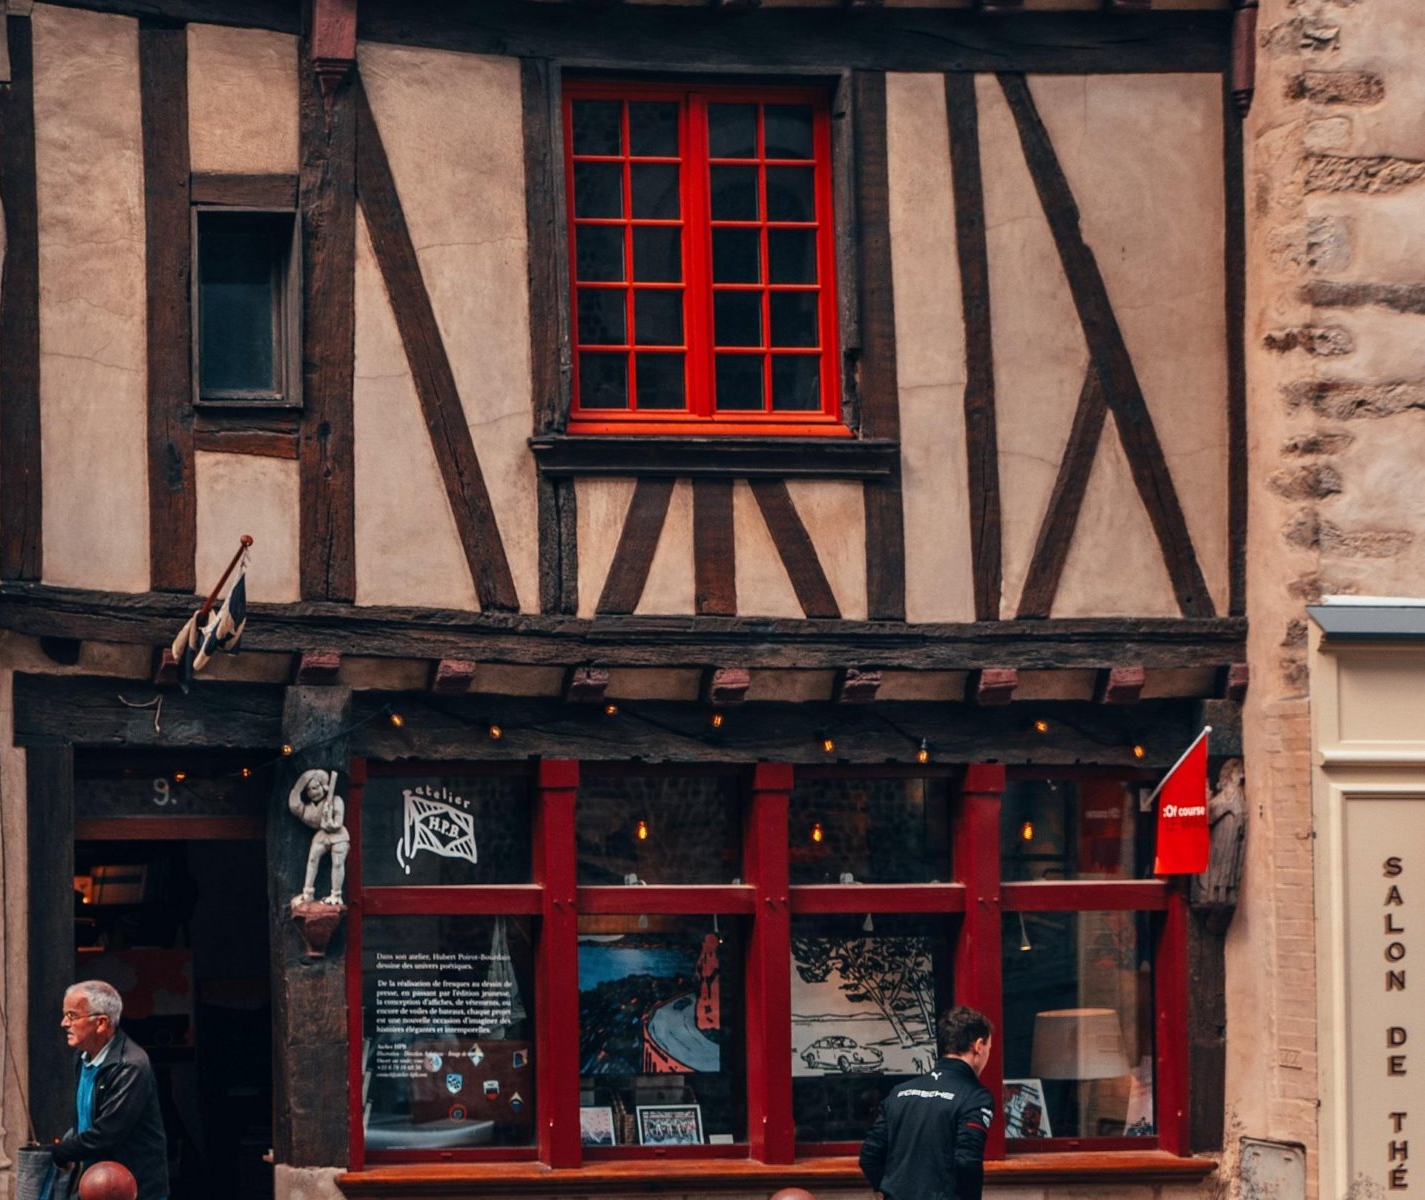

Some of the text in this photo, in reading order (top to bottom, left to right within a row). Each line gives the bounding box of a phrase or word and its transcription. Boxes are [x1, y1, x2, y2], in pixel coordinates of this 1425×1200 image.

[415, 785, 470, 808] atelier
[1178, 806, 1205, 817] course
[429, 816, 459, 839] H.P.B.
[376, 953, 393, 961] Dans
[395, 953, 406, 961] son
[409, 953, 431, 961] atelier,
[433, 953, 456, 961] Hubert
[376, 962, 473, 970] dessine des univers poétiques.
[378, 980, 512, 988] De la réalisation de fresques au dessin de
[376, 989, 399, 998] presse,
[401, 989, 410, 998] en
[412, 989, 436, 998] passant
[439, 989, 450, 998] par
[482, 989, 511, 998] jeunesse,
[376, 1008, 511, 1016] encore de voiles de bateaux, chaque projet
[376, 1016, 386, 1024] est
[388, 1016, 401, 1024] une
[403, 1016, 430, 1024] nouvelle
[432, 1016, 461, 1024] occasion
[500, 1016, 511, 1024] des
[1383, 857, 1408, 1191] SALON DE THÉ
[376, 1026, 404, 1034] histoires
[406, 1026, 436, 1034] élégantes
[437, 1026, 443, 1034] et
[897, 1088, 955, 1101] PORSCHE
